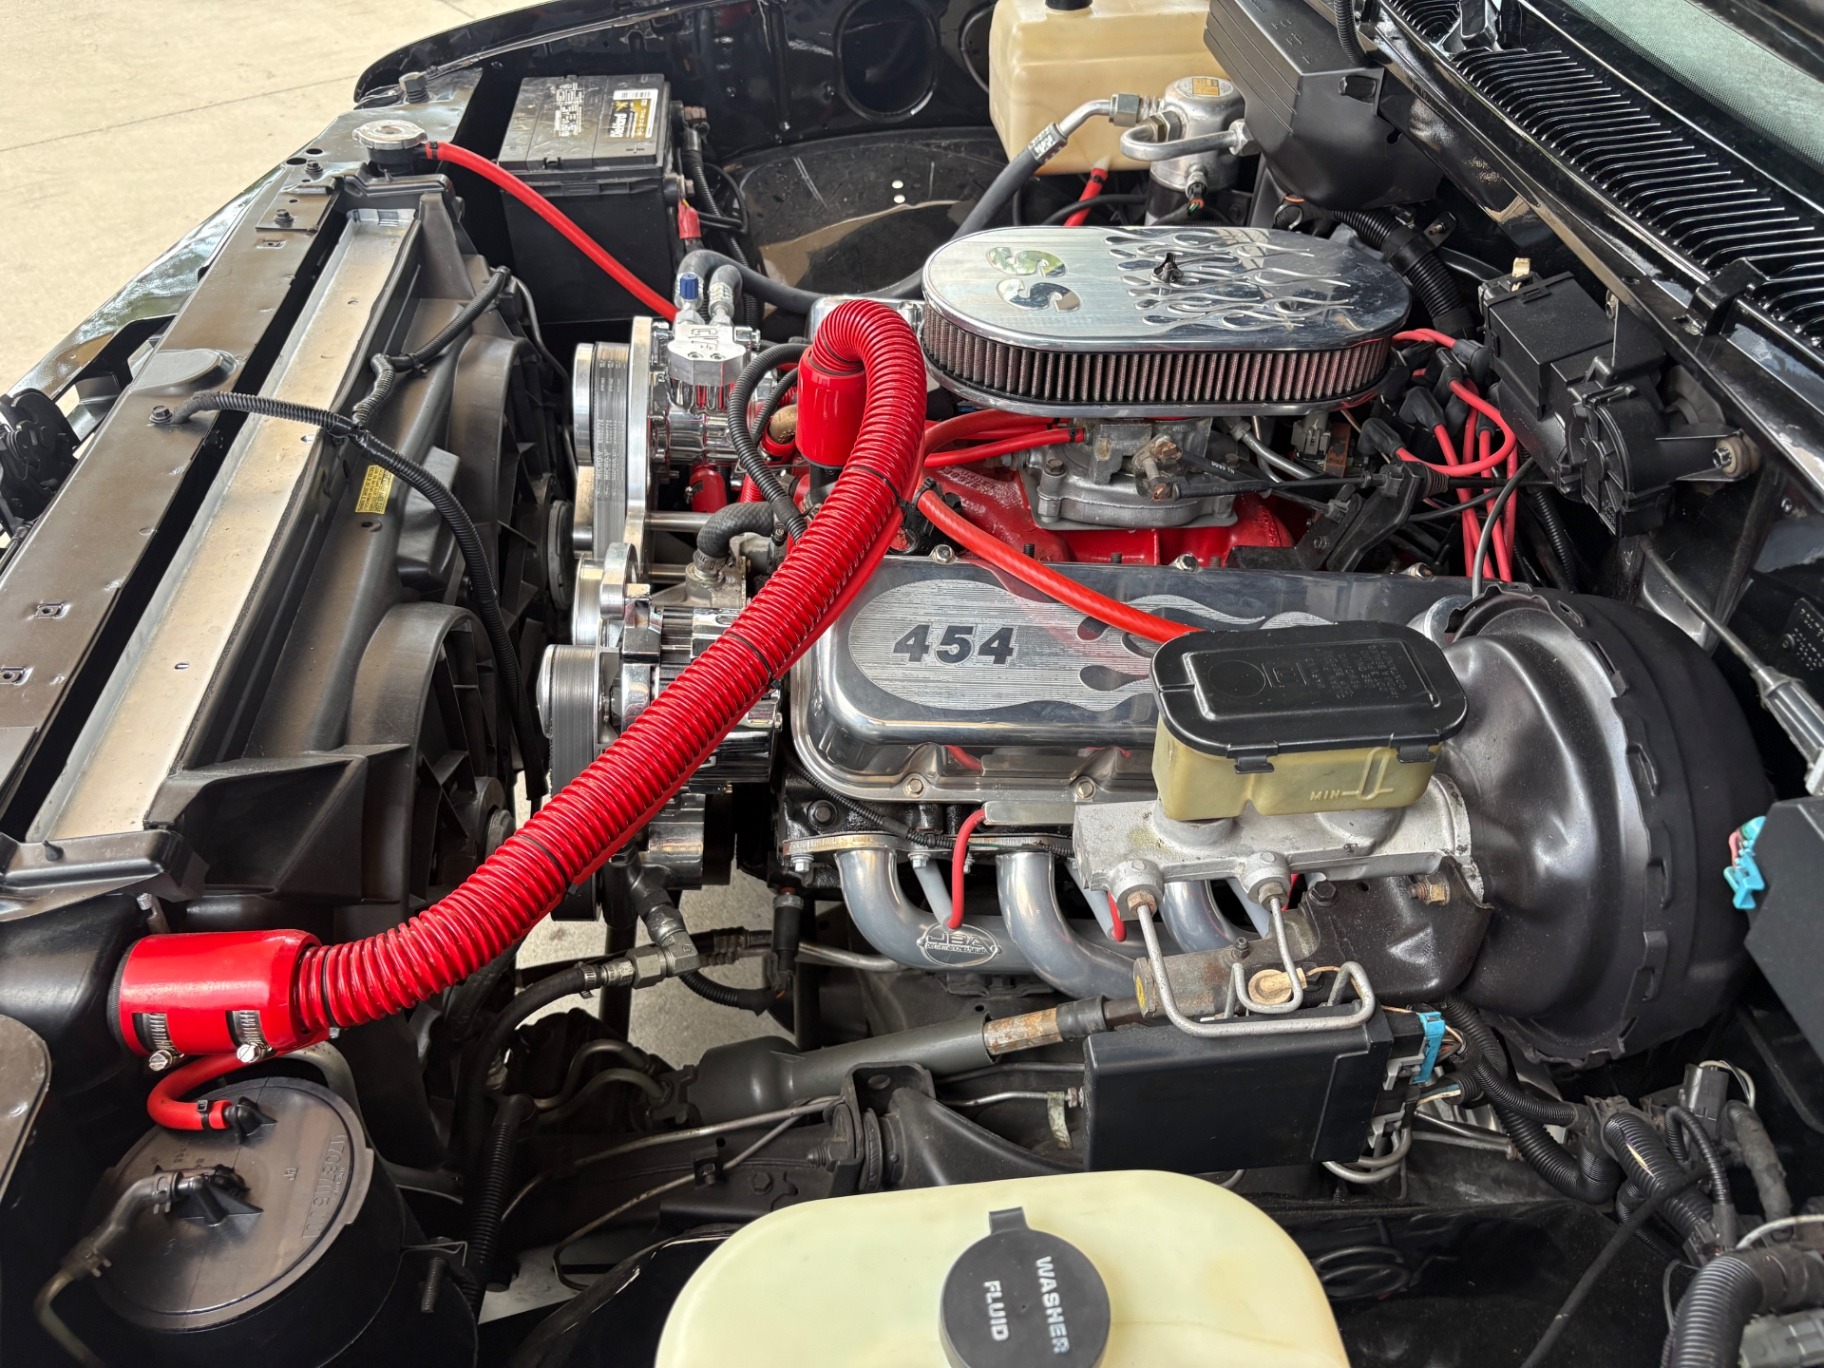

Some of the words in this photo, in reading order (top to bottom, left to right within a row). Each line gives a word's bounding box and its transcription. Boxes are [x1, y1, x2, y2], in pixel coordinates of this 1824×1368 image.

[610, 113, 628, 138] DieHard
[892, 623, 1015, 665] 454
[1309, 789, 1341, 801] MIN
[927, 933, 990, 955] JBA
[983, 1280, 1009, 1341] FLUID
[1036, 1256, 1070, 1354] WASHER
